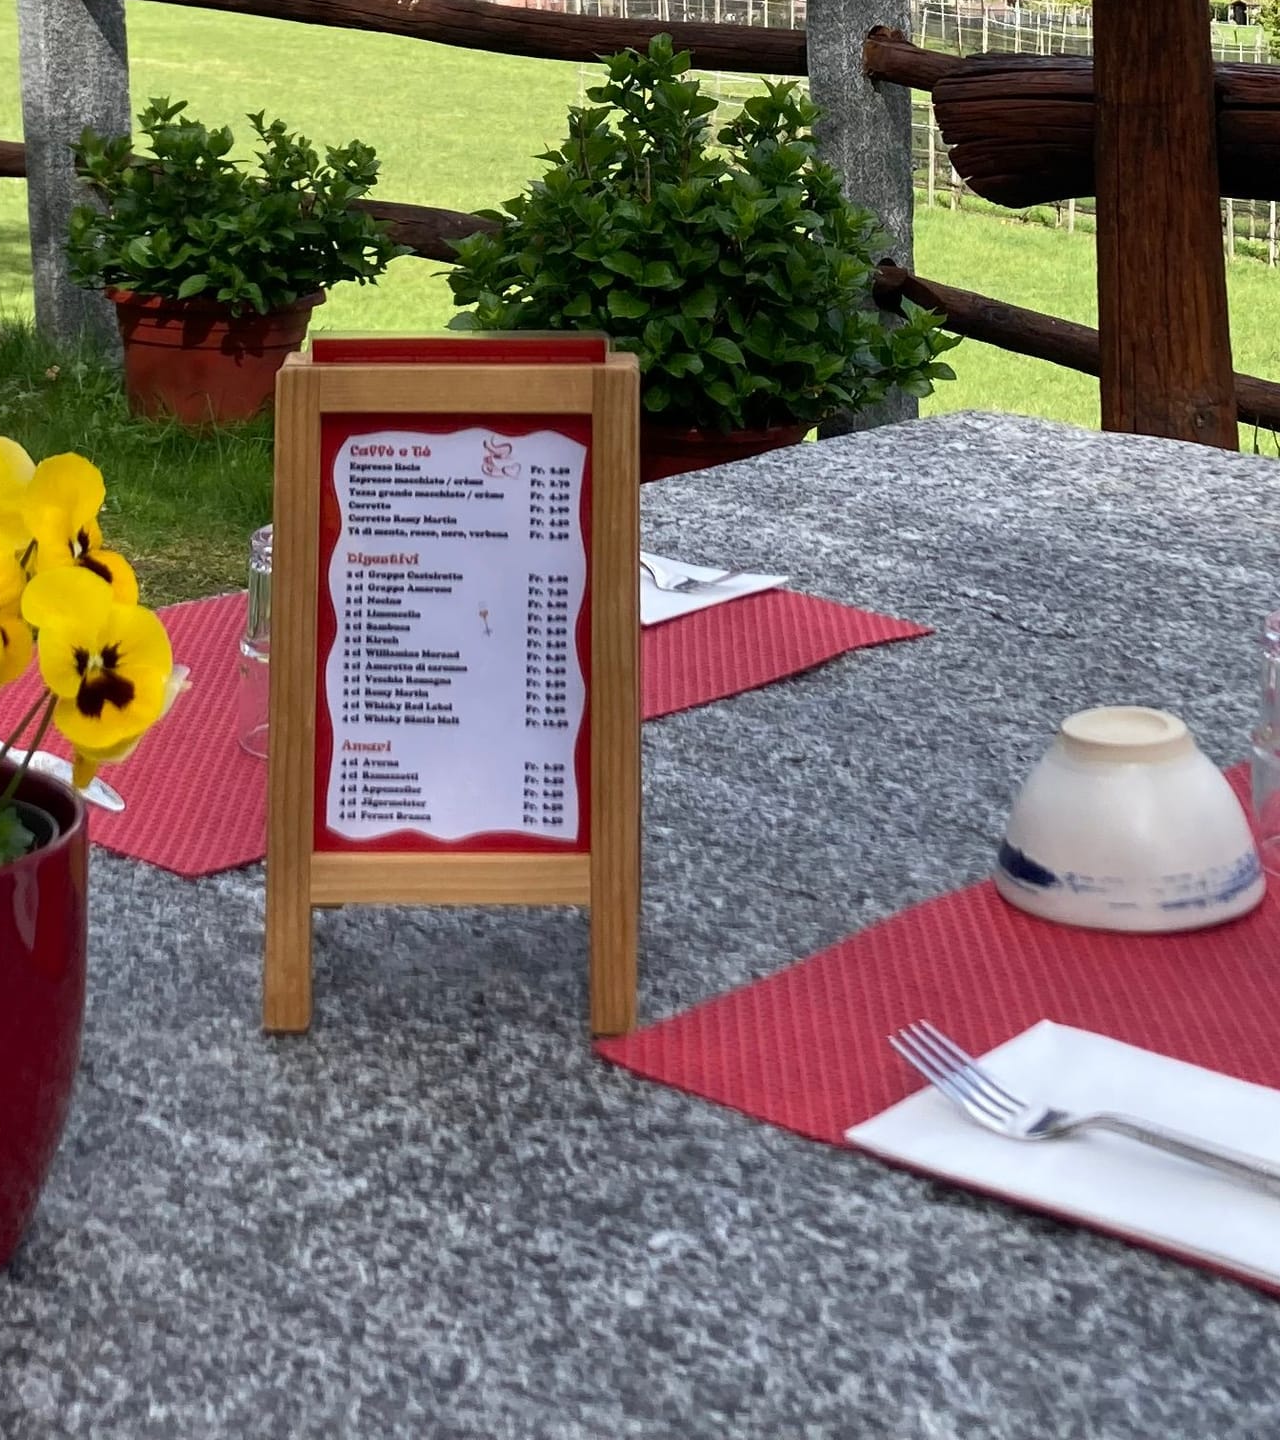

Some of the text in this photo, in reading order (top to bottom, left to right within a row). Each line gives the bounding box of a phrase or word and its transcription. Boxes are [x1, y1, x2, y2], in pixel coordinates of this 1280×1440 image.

[530, 464, 545, 475] Fr.
[529, 477, 545, 488] Fr.
[529, 490, 545, 501] Fr.
[529, 503, 545, 514] Fr.
[529, 516, 544, 527] Fr.
[528, 529, 544, 540] Fr.
[527, 573, 544, 584] Fr.
[527, 585, 544, 597] Fr.
[527, 599, 543, 610] Fr.
[527, 612, 543, 623] Fr.
[526, 625, 542, 636] Fr.
[526, 638, 542, 649] Fr.
[526, 651, 542, 662] Fr.
[525, 664, 541, 675] Fr.
[525, 677, 541, 688] Fr.
[525, 690, 541, 701] Fr.
[525, 703, 541, 715] Fr.
[524, 717, 540, 728] Fr.
[523, 761, 539, 772] Fr.
[523, 774, 539, 785] Fr.
[522, 787, 538, 799] Fr.
[522, 800, 538, 812] Fr.
[522, 814, 538, 826] Fr.
